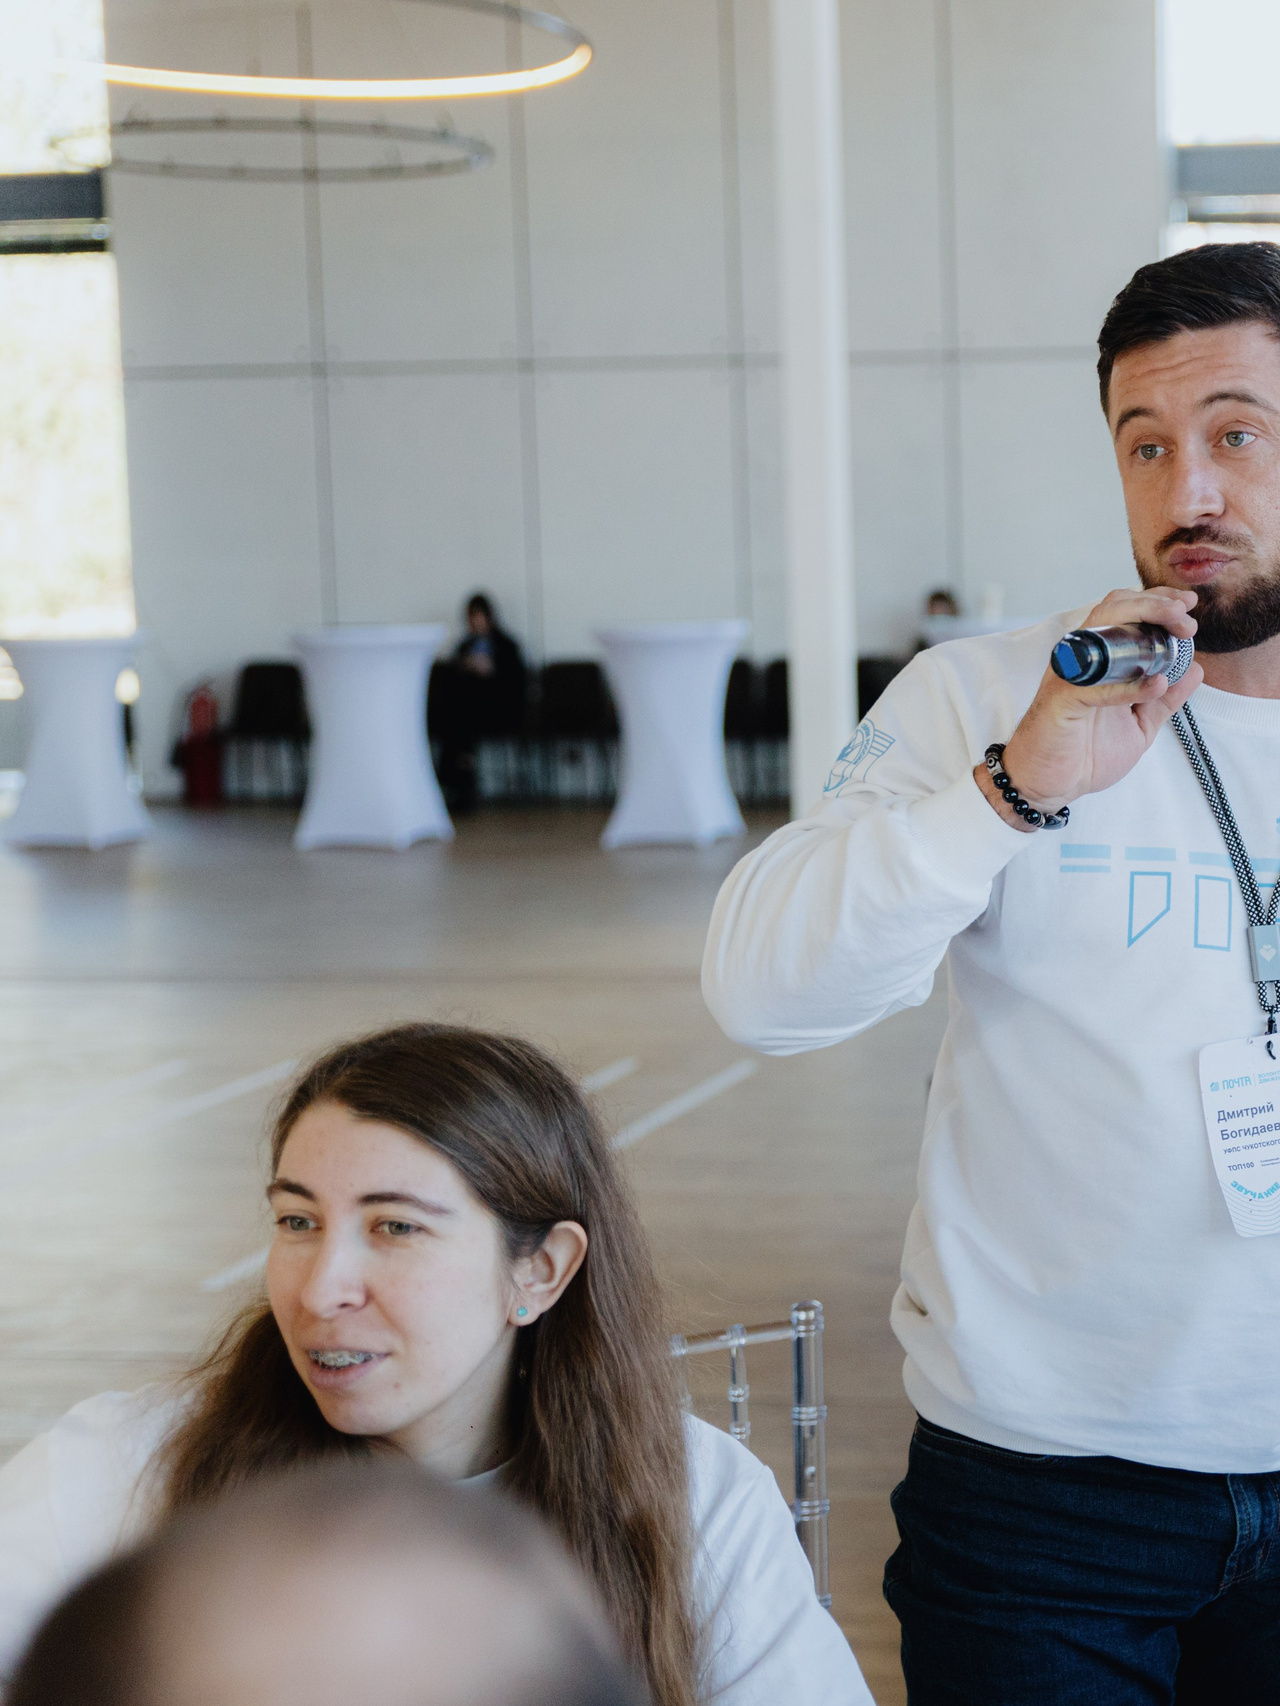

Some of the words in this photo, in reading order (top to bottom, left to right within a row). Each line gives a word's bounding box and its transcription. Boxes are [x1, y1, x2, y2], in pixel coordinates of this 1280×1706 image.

[1222, 1075, 1252, 1091] ПОЧТА
[1217, 1101, 1275, 1124] Дмитрий
[1223, 1146, 1241, 1155] УФПС
[1227, 1161, 1255, 1172] ТОП100
